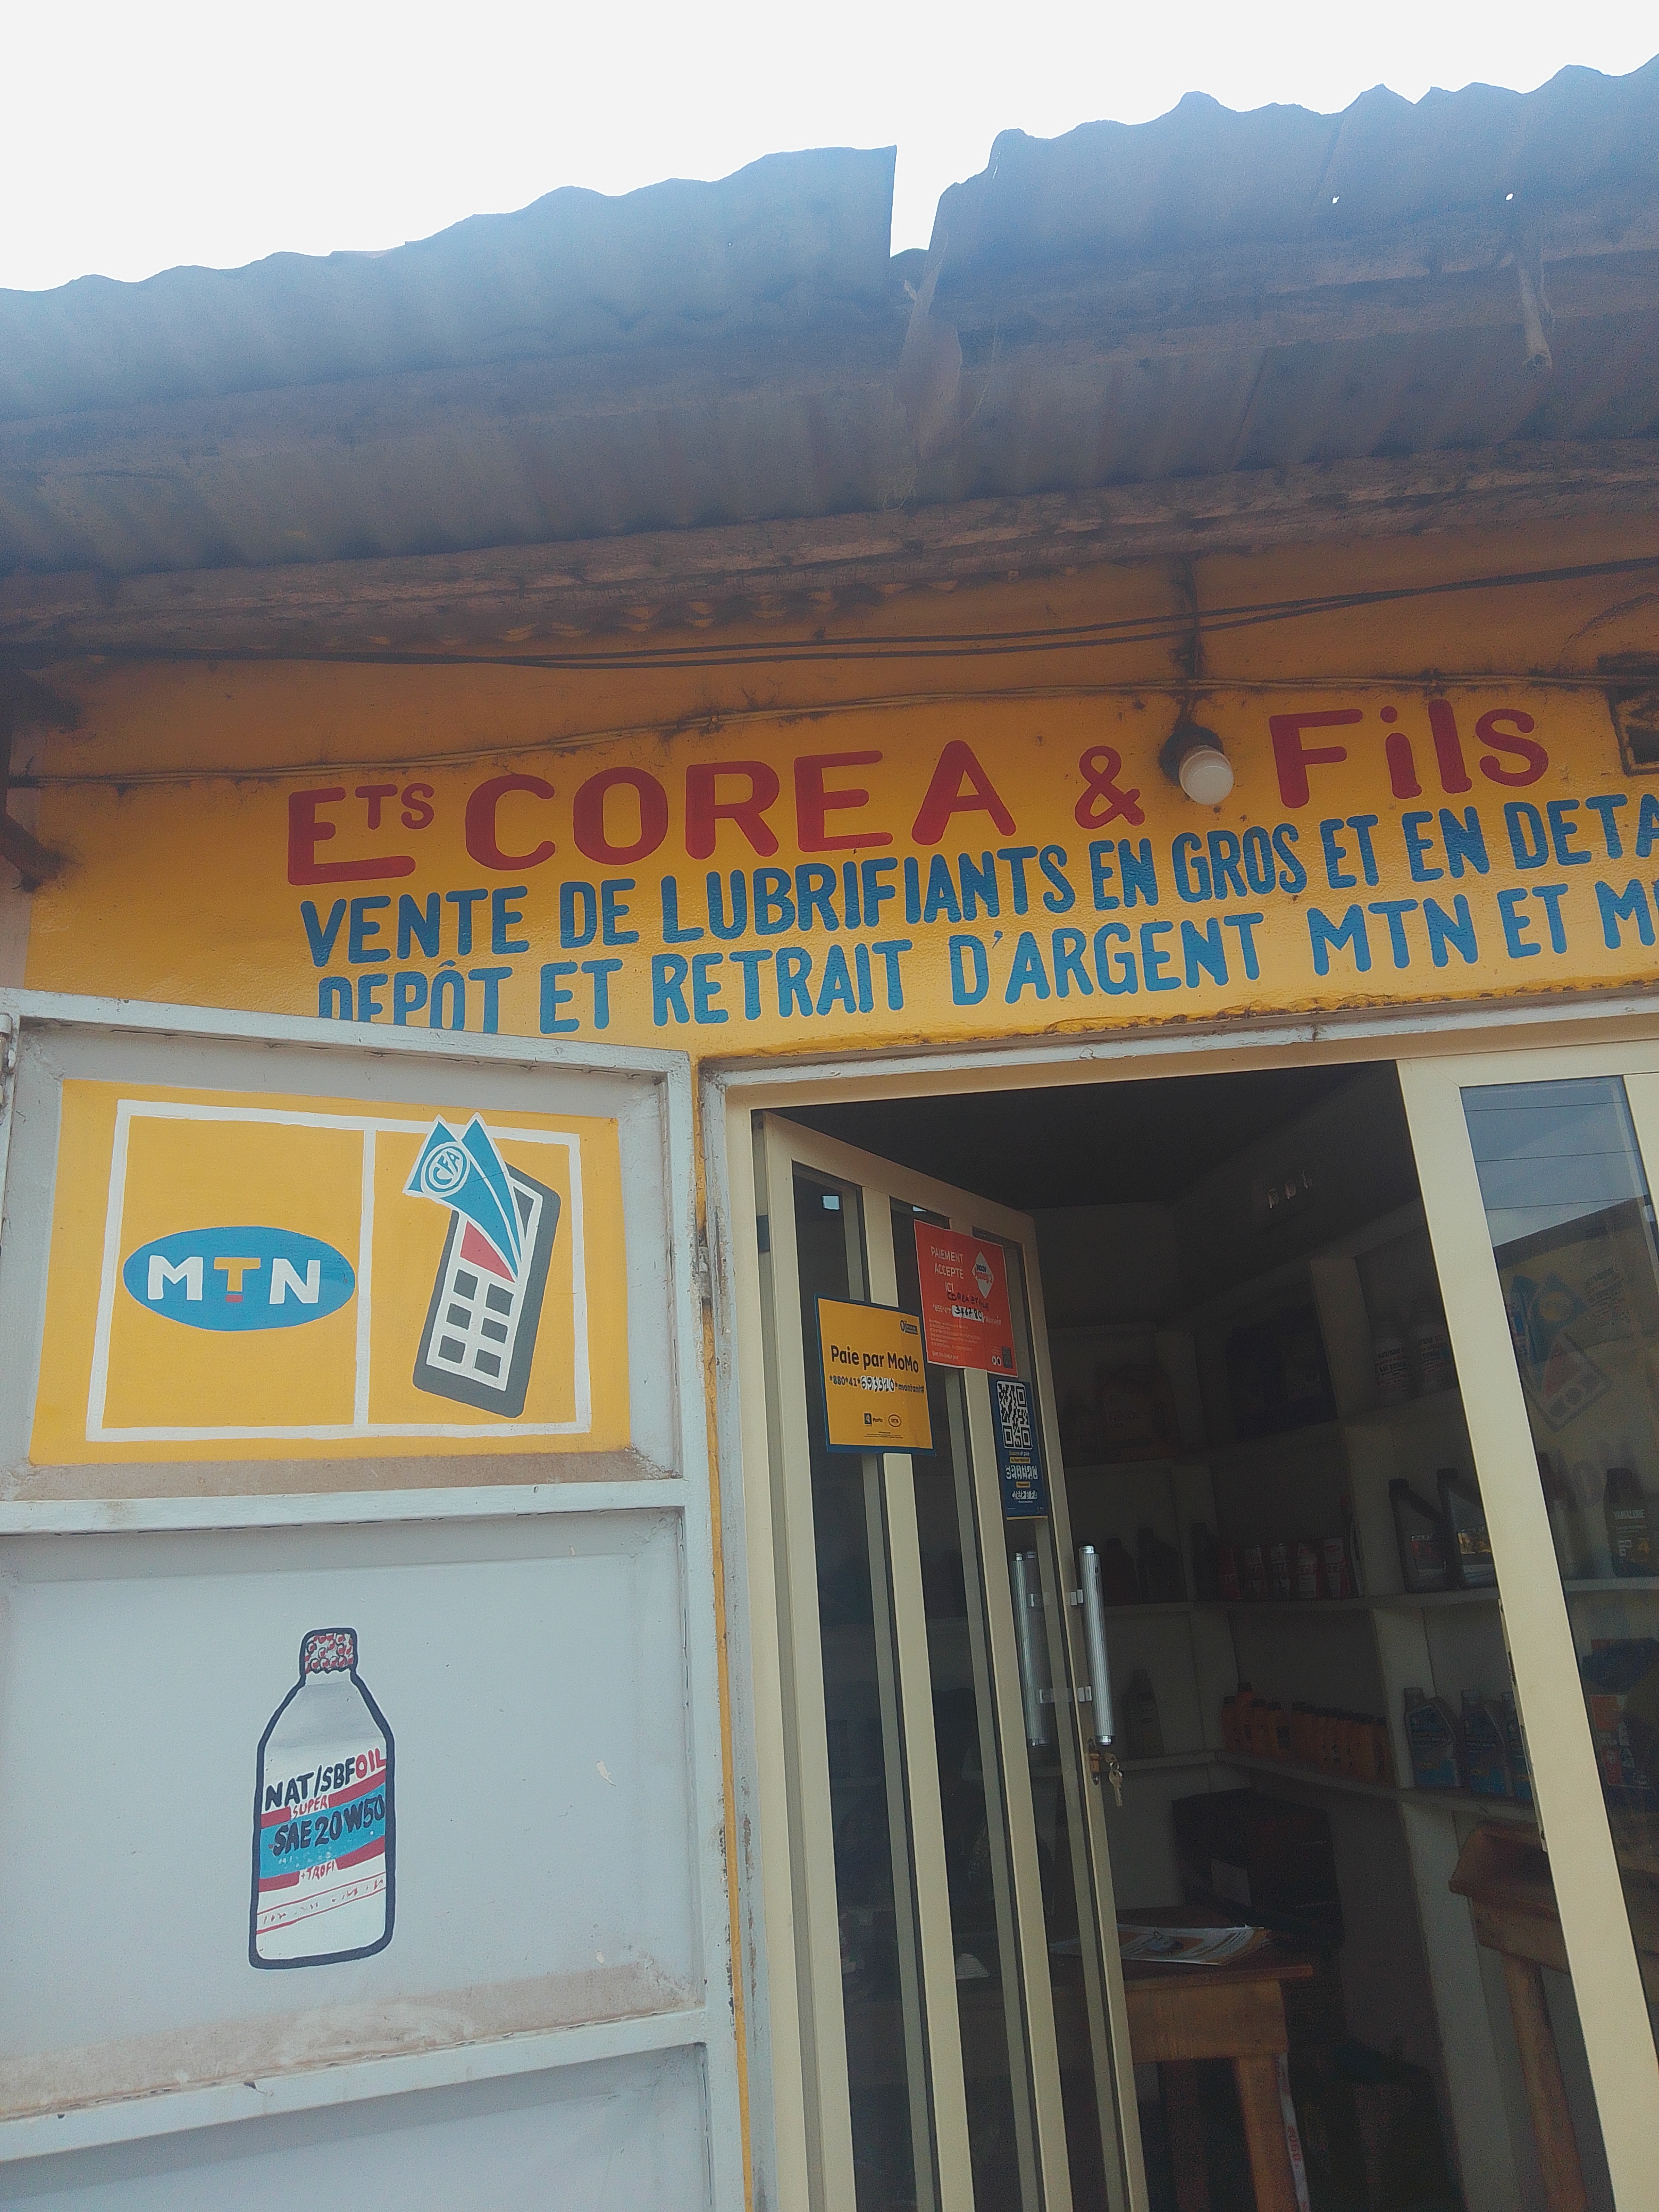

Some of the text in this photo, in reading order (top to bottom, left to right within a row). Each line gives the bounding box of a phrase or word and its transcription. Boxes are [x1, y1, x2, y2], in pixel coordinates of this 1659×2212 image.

[465, 740, 1016, 871] COREA
[1075, 745, 1145, 829] &
[300, 886, 530, 968] VENTE
[560, 878, 639, 949] DE
[661, 844, 1075, 944] LUBRIFIANTS
[1089, 839, 1158, 911] EN
[1172, 824, 1306, 902] GROS
[1319, 814, 1379, 889] ET
[1402, 806, 1489, 882] EN
[540, 958, 623, 1034] ET
[652, 939, 912, 1026] RETRAIT
[949, 912, 1263, 1006] D'ARGENT
[1306, 894, 1478, 976] MTN
[1497, 883, 1568, 958] ET
[1595, 878, 1659, 949] M
[433, 1151, 460, 1185] CFA
[931, 1246, 963, 1263] PAIEMENT
[147, 1255, 321, 1303] MTN
[945, 1281, 954, 1293] ICI
[831, 1345, 859, 1365] Paie
[863, 1353, 885, 1371] par
[887, 1352, 919, 1373] MoMo
[272, 1794, 384, 1857] SAE 20W50
[293, 1795, 328, 1819] SUPER
